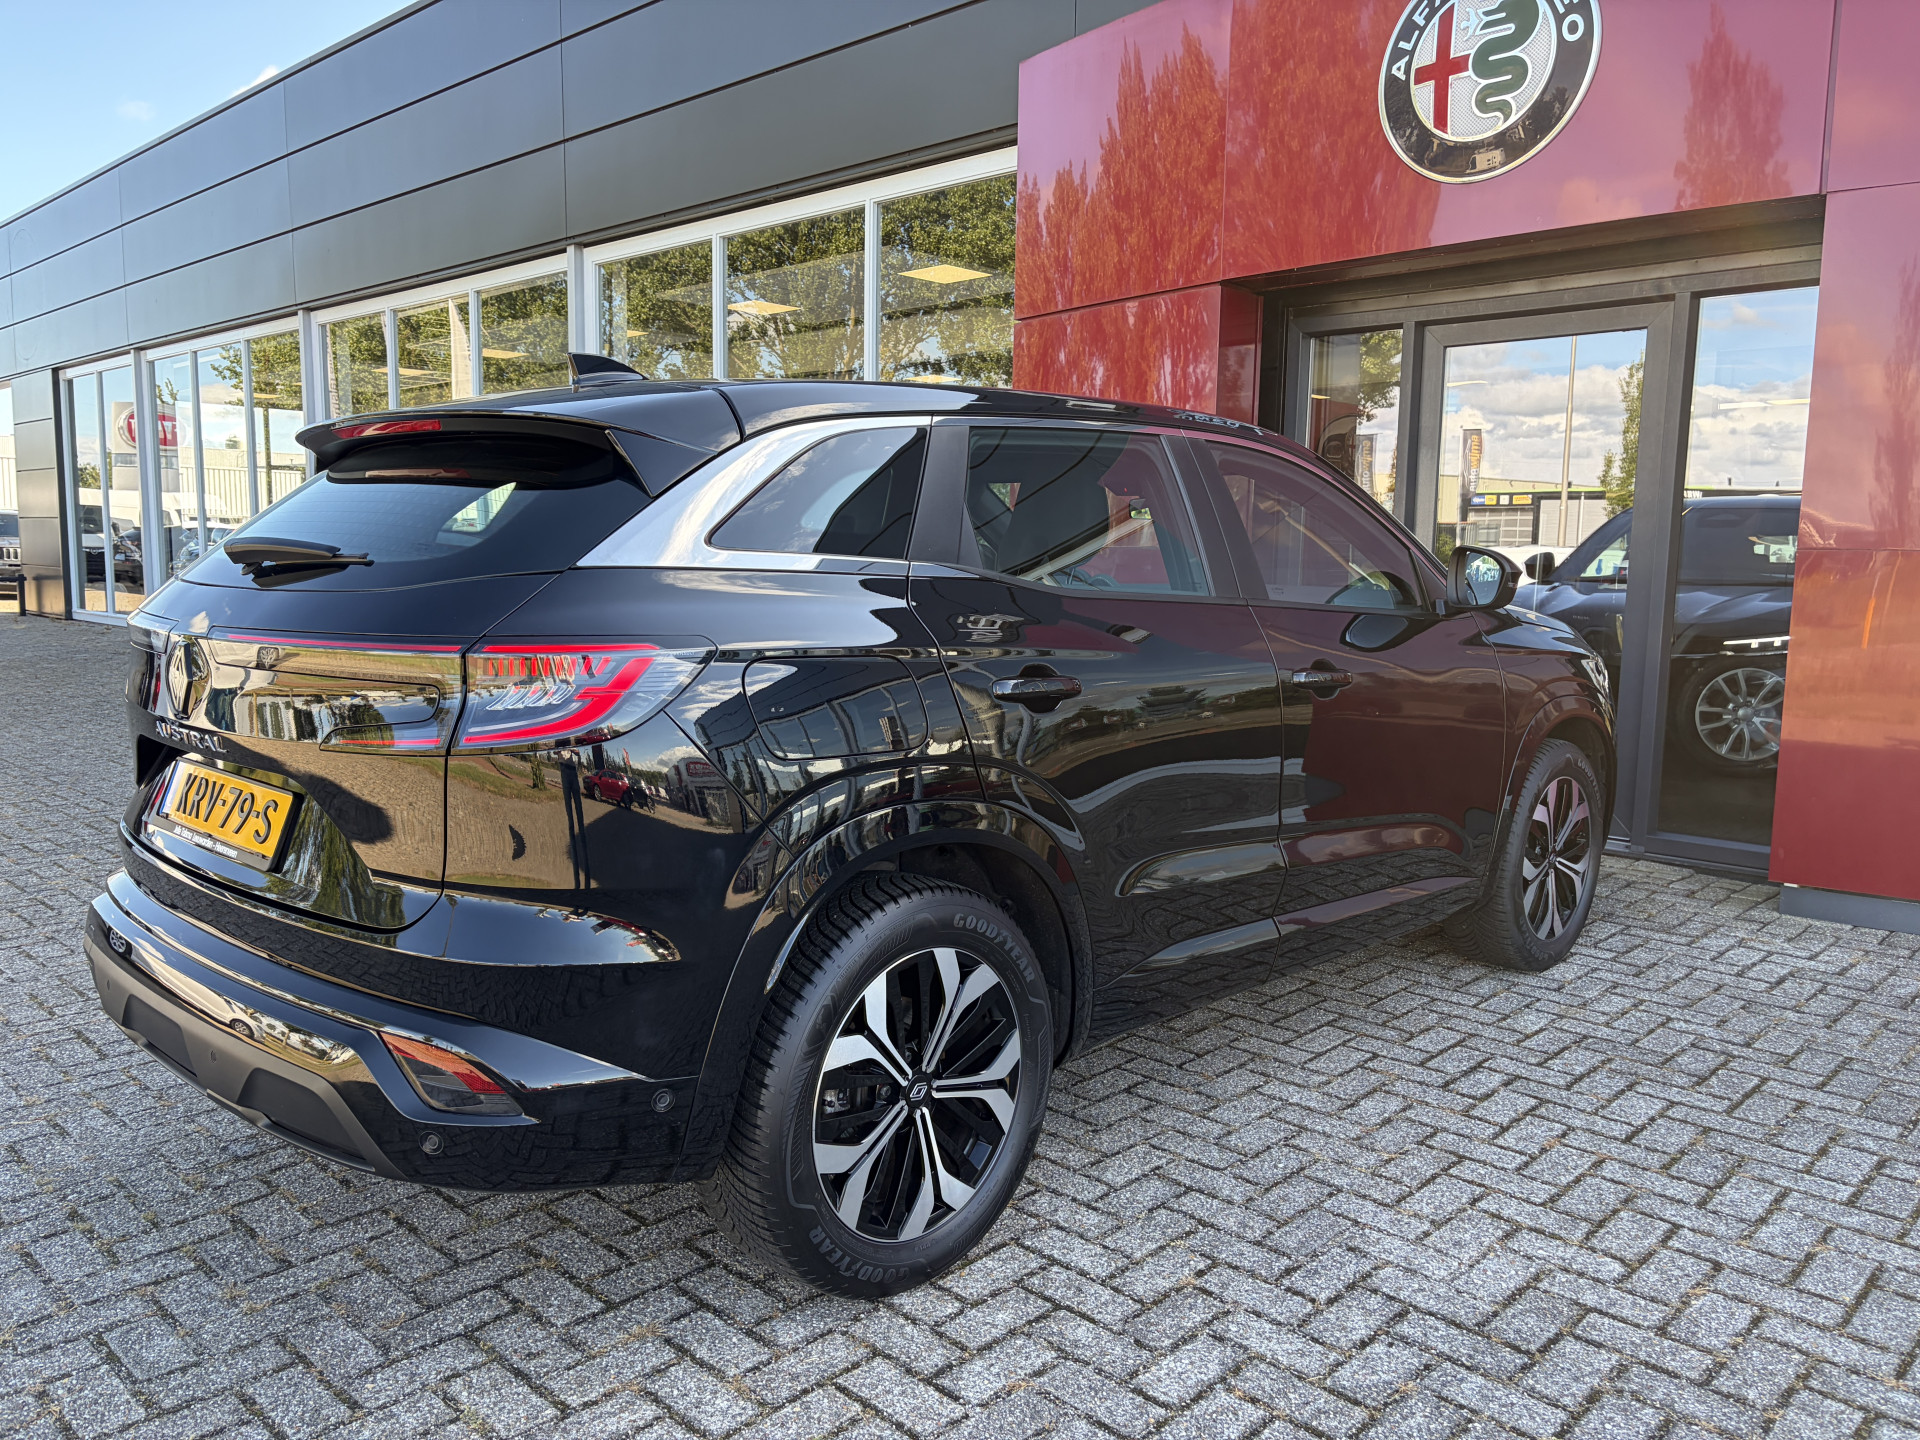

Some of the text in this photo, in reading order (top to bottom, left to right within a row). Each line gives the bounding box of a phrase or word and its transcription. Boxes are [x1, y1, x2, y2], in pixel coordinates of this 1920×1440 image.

[1391, 0, 1443, 81] ALF
[156, 720, 228, 753] AUSTRAL
[175, 772, 279, 845] KRV-79-S
[953, 913, 1035, 983] GOODYEAR
[808, 1225, 910, 1284] GOODYEAR
